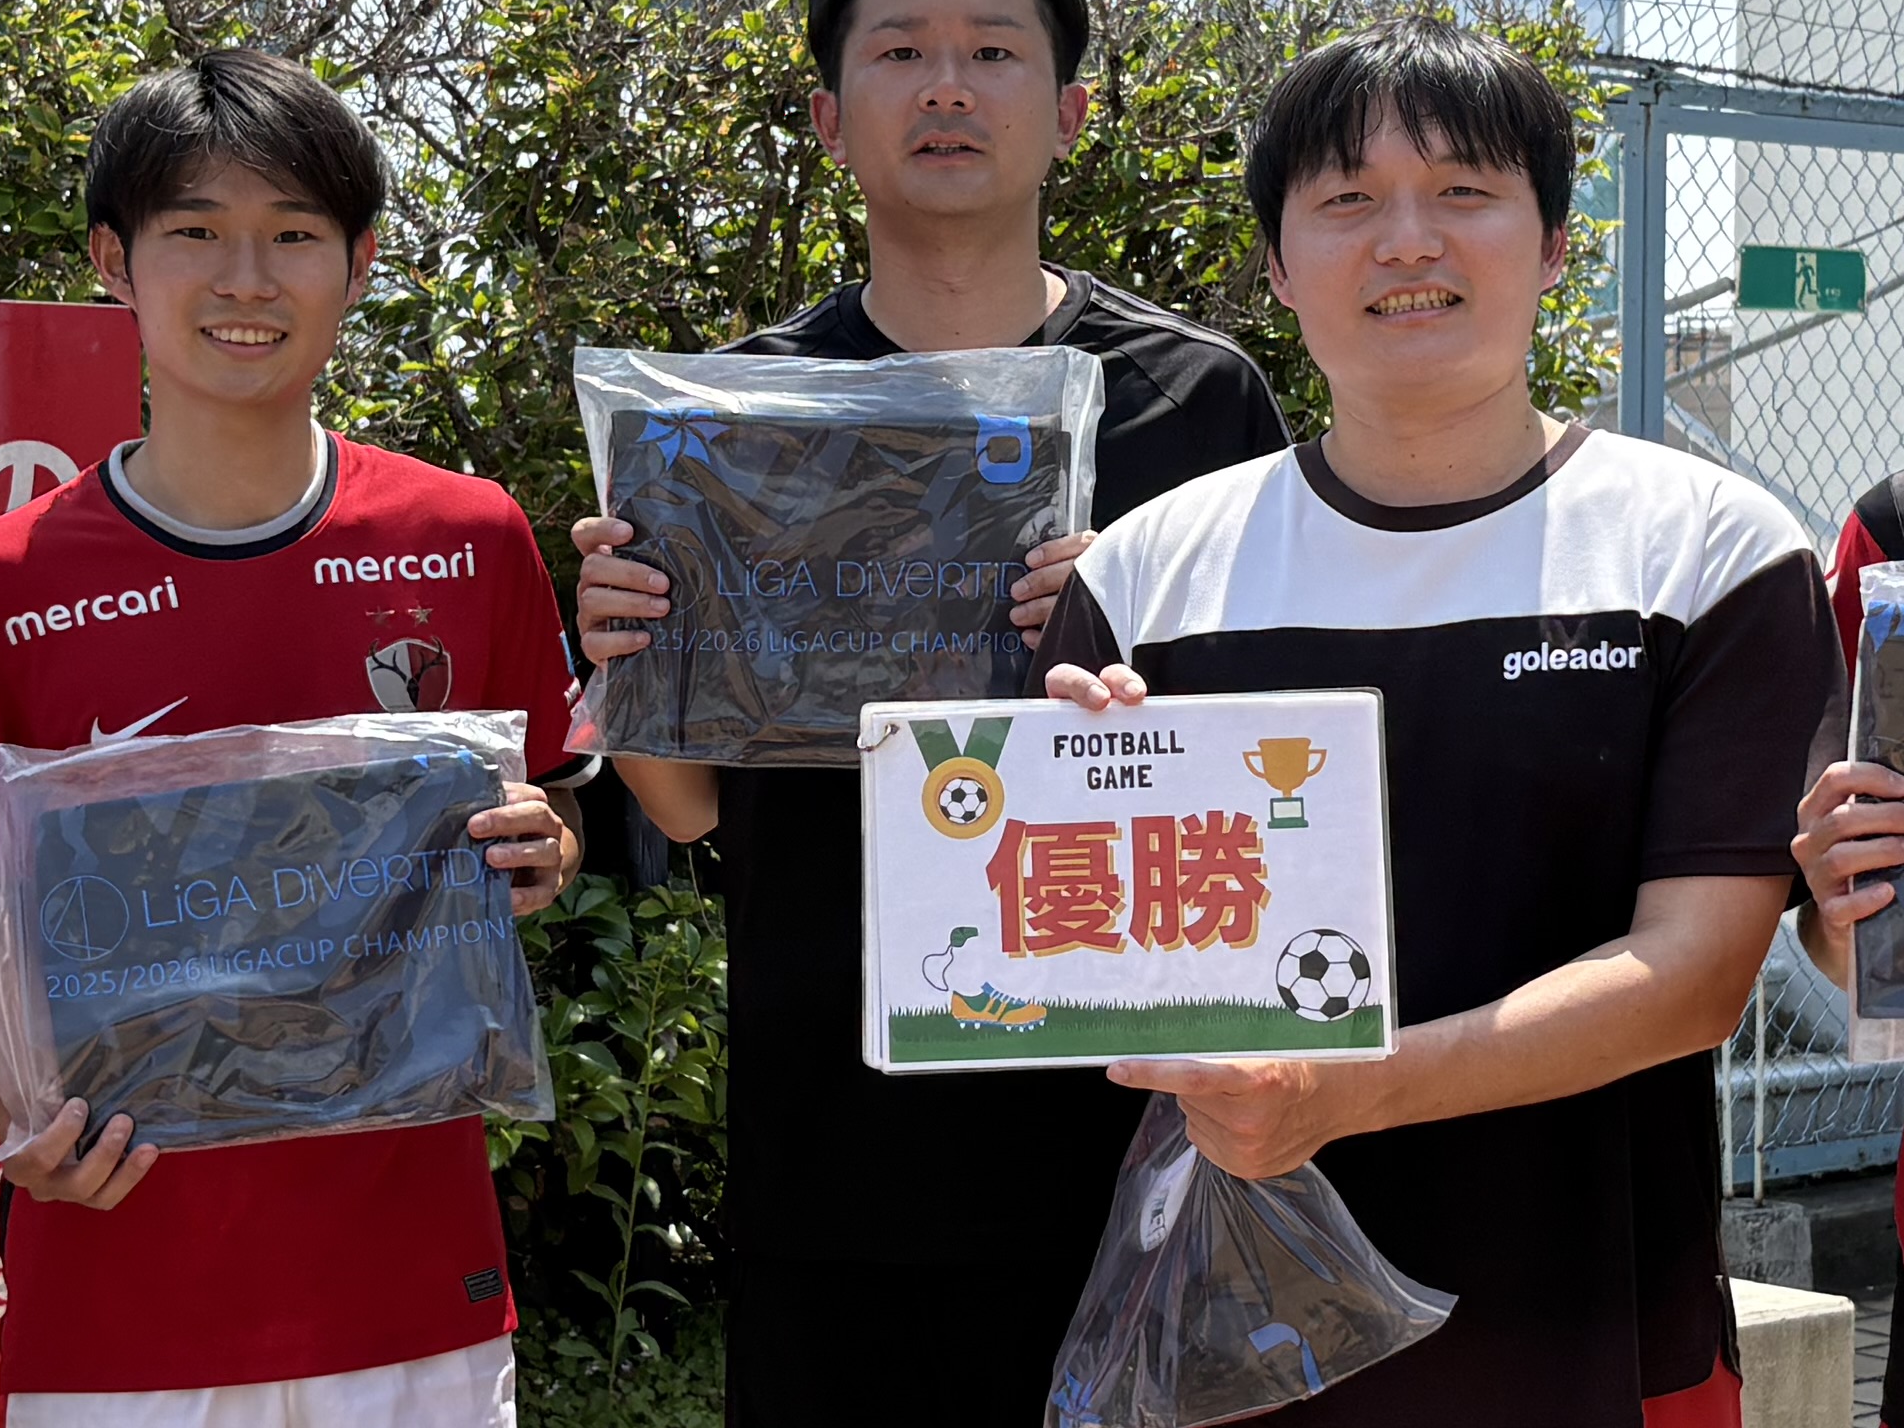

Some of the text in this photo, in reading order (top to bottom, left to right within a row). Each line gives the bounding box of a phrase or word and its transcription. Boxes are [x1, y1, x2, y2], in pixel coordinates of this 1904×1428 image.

[314, 542, 476, 586] mercari
[836, 560, 1028, 598] DiVeRTiD
[5, 575, 180, 647] mercari
[652, 628, 760, 653] 25/2026
[892, 630, 1030, 654] CHAMPIO
[1503, 641, 1642, 680] goleador
[1053, 730, 1185, 759] FOOTBALL
[1086, 764, 1153, 791] GAME
[985, 810, 1272, 958] 優勝
[47, 959, 200, 999] 2025/2026
